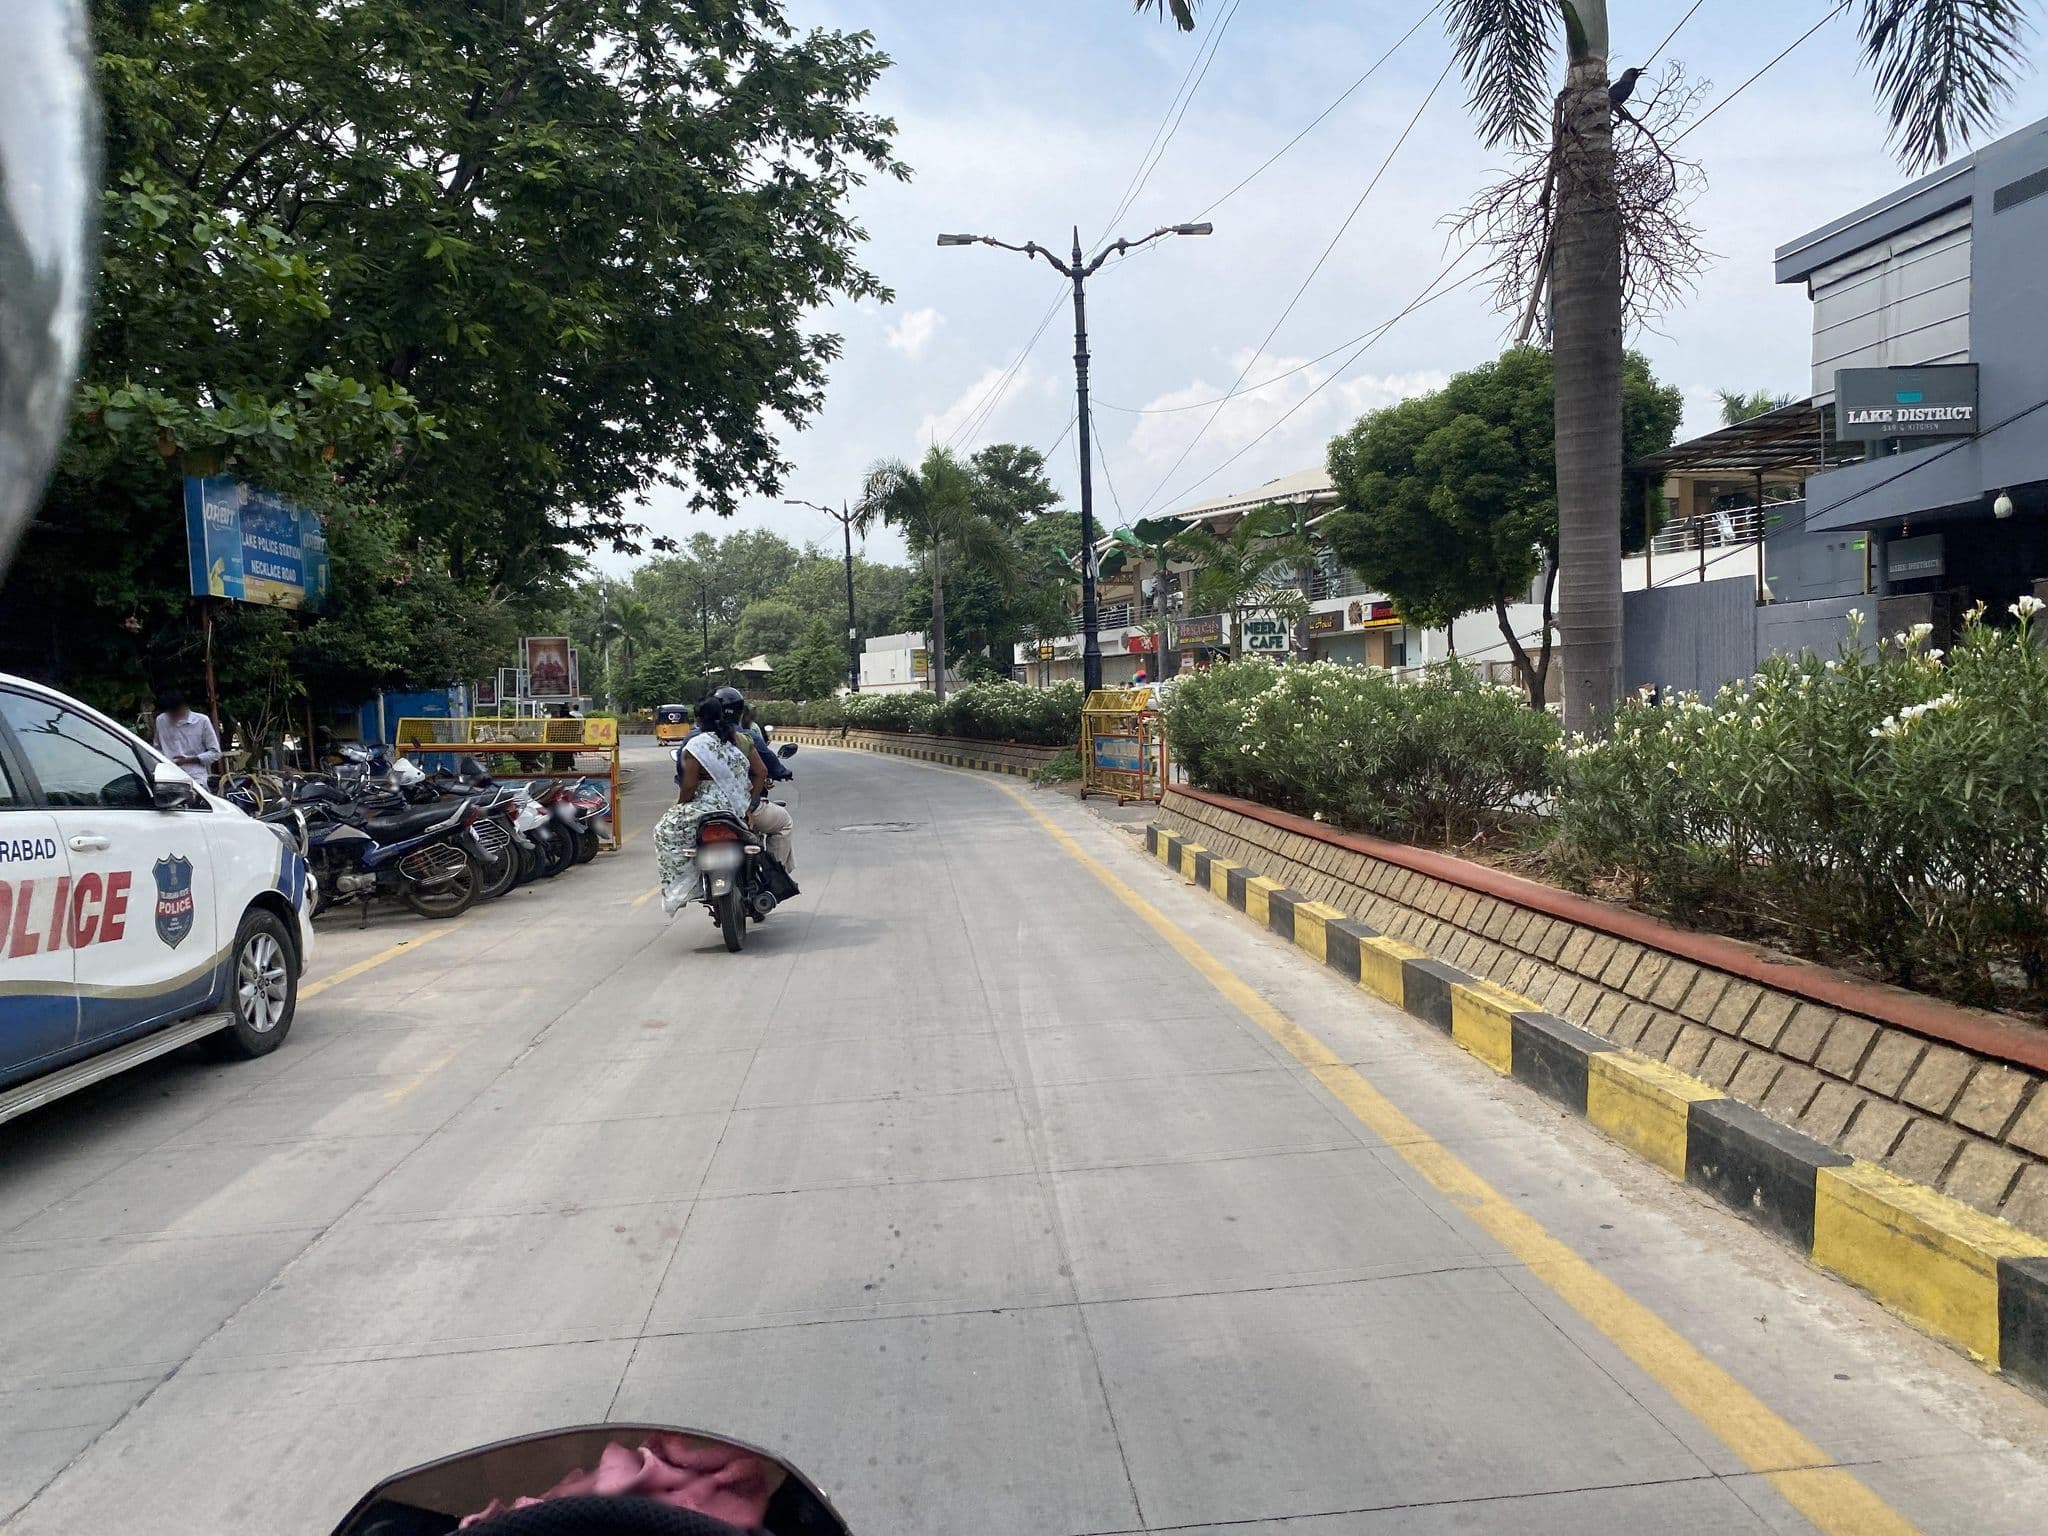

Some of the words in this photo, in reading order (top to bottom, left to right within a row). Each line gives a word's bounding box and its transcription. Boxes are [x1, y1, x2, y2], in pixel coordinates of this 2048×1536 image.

[1847, 409, 1893, 424] LAKE
[1897, 406, 1973, 421] DISTRICT
[241, 532, 257, 550] LAKE
[258, 536, 279, 555] POLICE
[279, 542, 301, 560] STATION
[251, 560, 281, 579] NECKLACE
[281, 565, 297, 582] ROAD
[1244, 620, 1287, 635] NEERA
[1249, 636, 1283, 649] CAFE
[158, 897, 191, 914] POLICE
